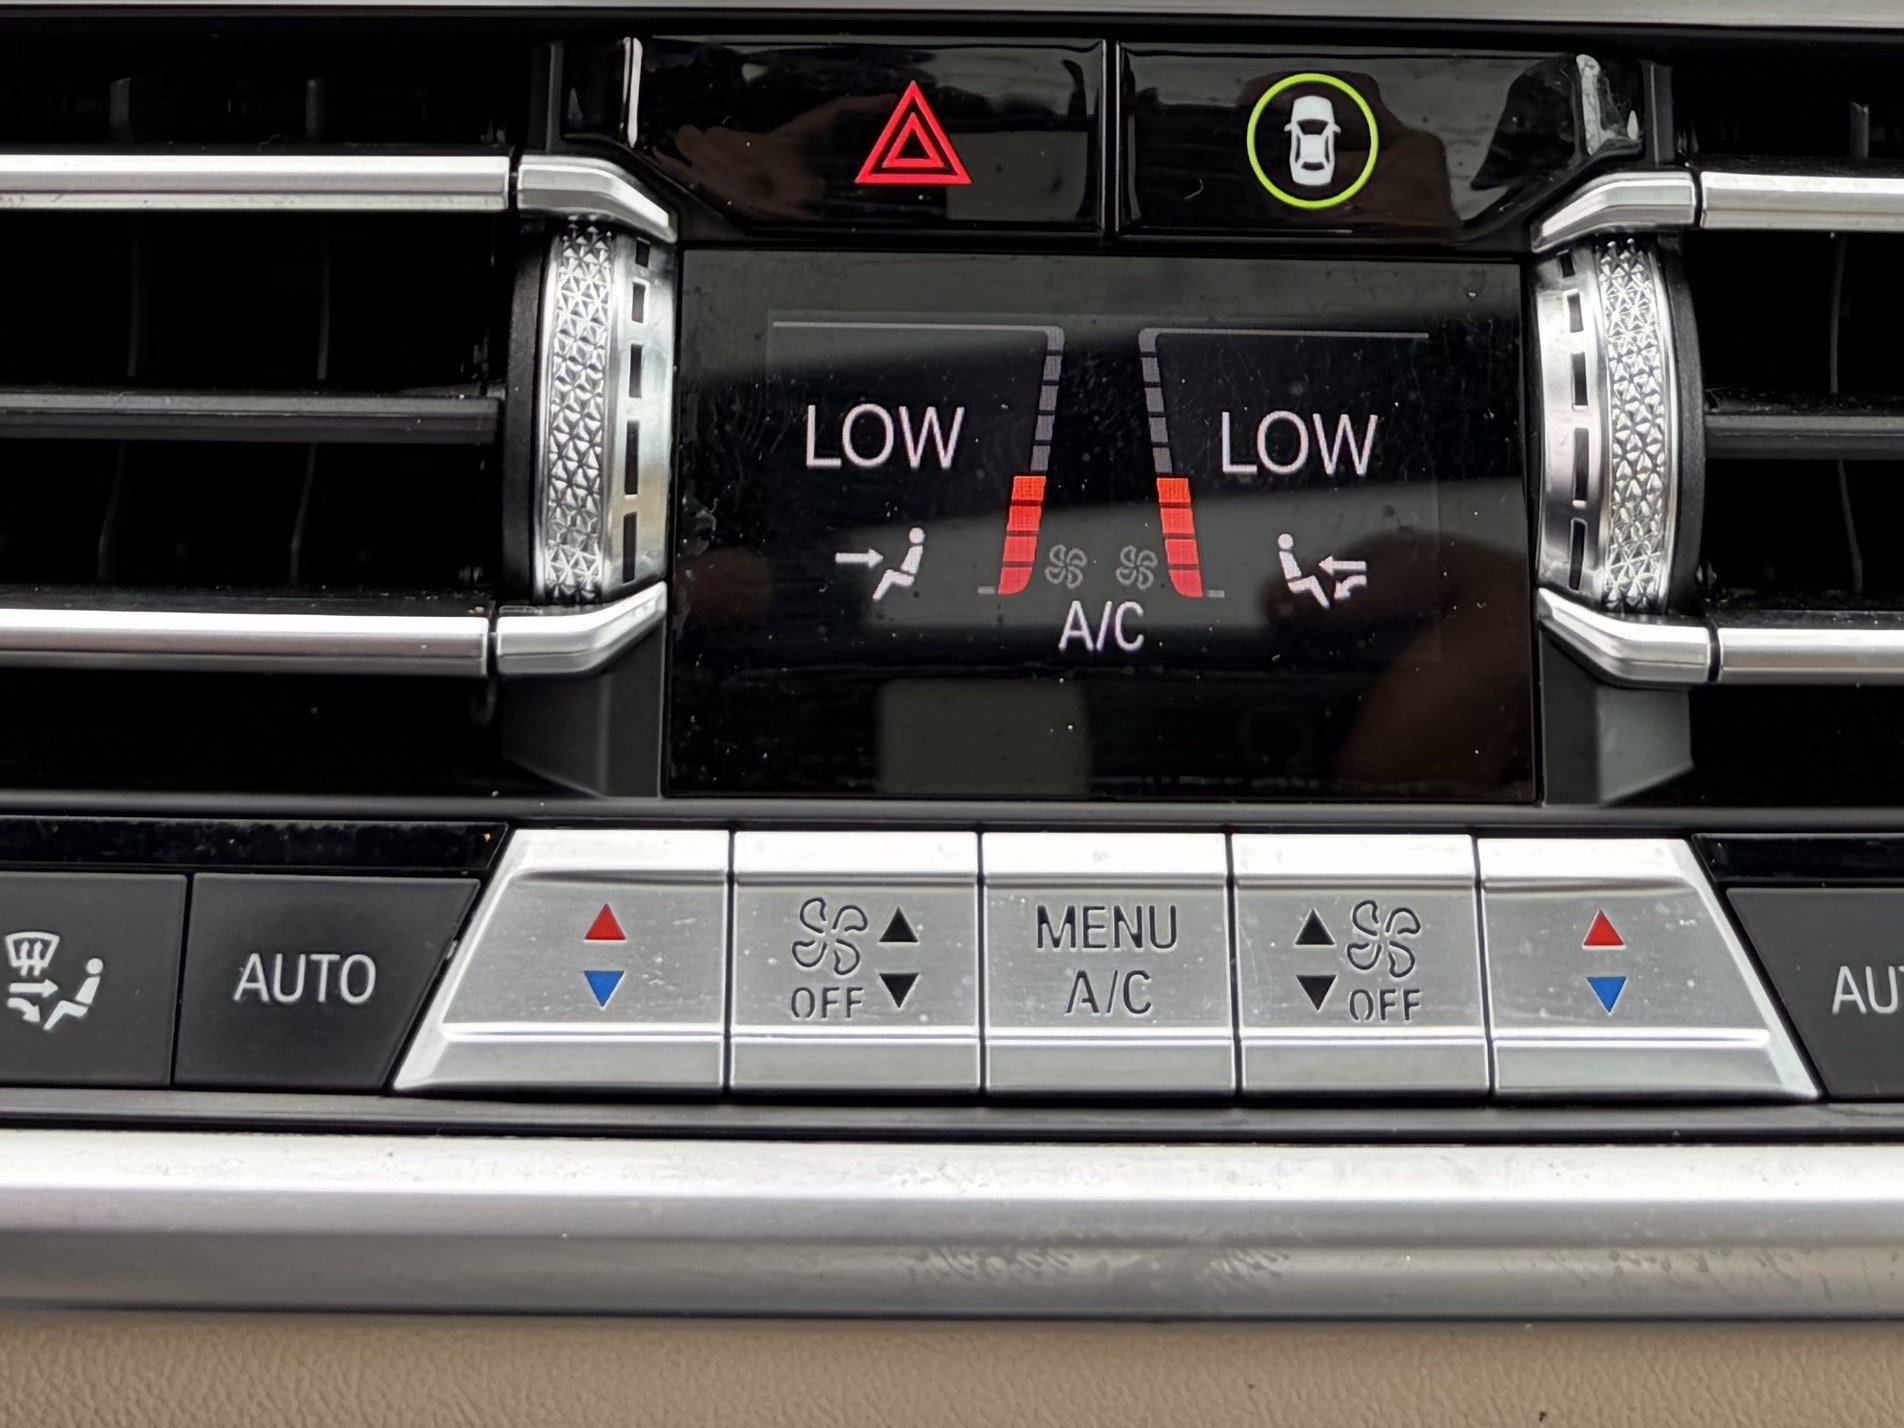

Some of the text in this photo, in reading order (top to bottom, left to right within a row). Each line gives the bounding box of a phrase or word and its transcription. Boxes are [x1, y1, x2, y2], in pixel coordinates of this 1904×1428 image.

[804, 404, 966, 472] LOW
[1220, 410, 1379, 478] LOW
[1058, 600, 1146, 652] A/C
[1035, 904, 1179, 951] MENU
[233, 951, 377, 1005] AUTO
[1064, 969, 1153, 1016] A/C
[789, 986, 865, 1020] OFF
[1347, 988, 1422, 1023] OFF
